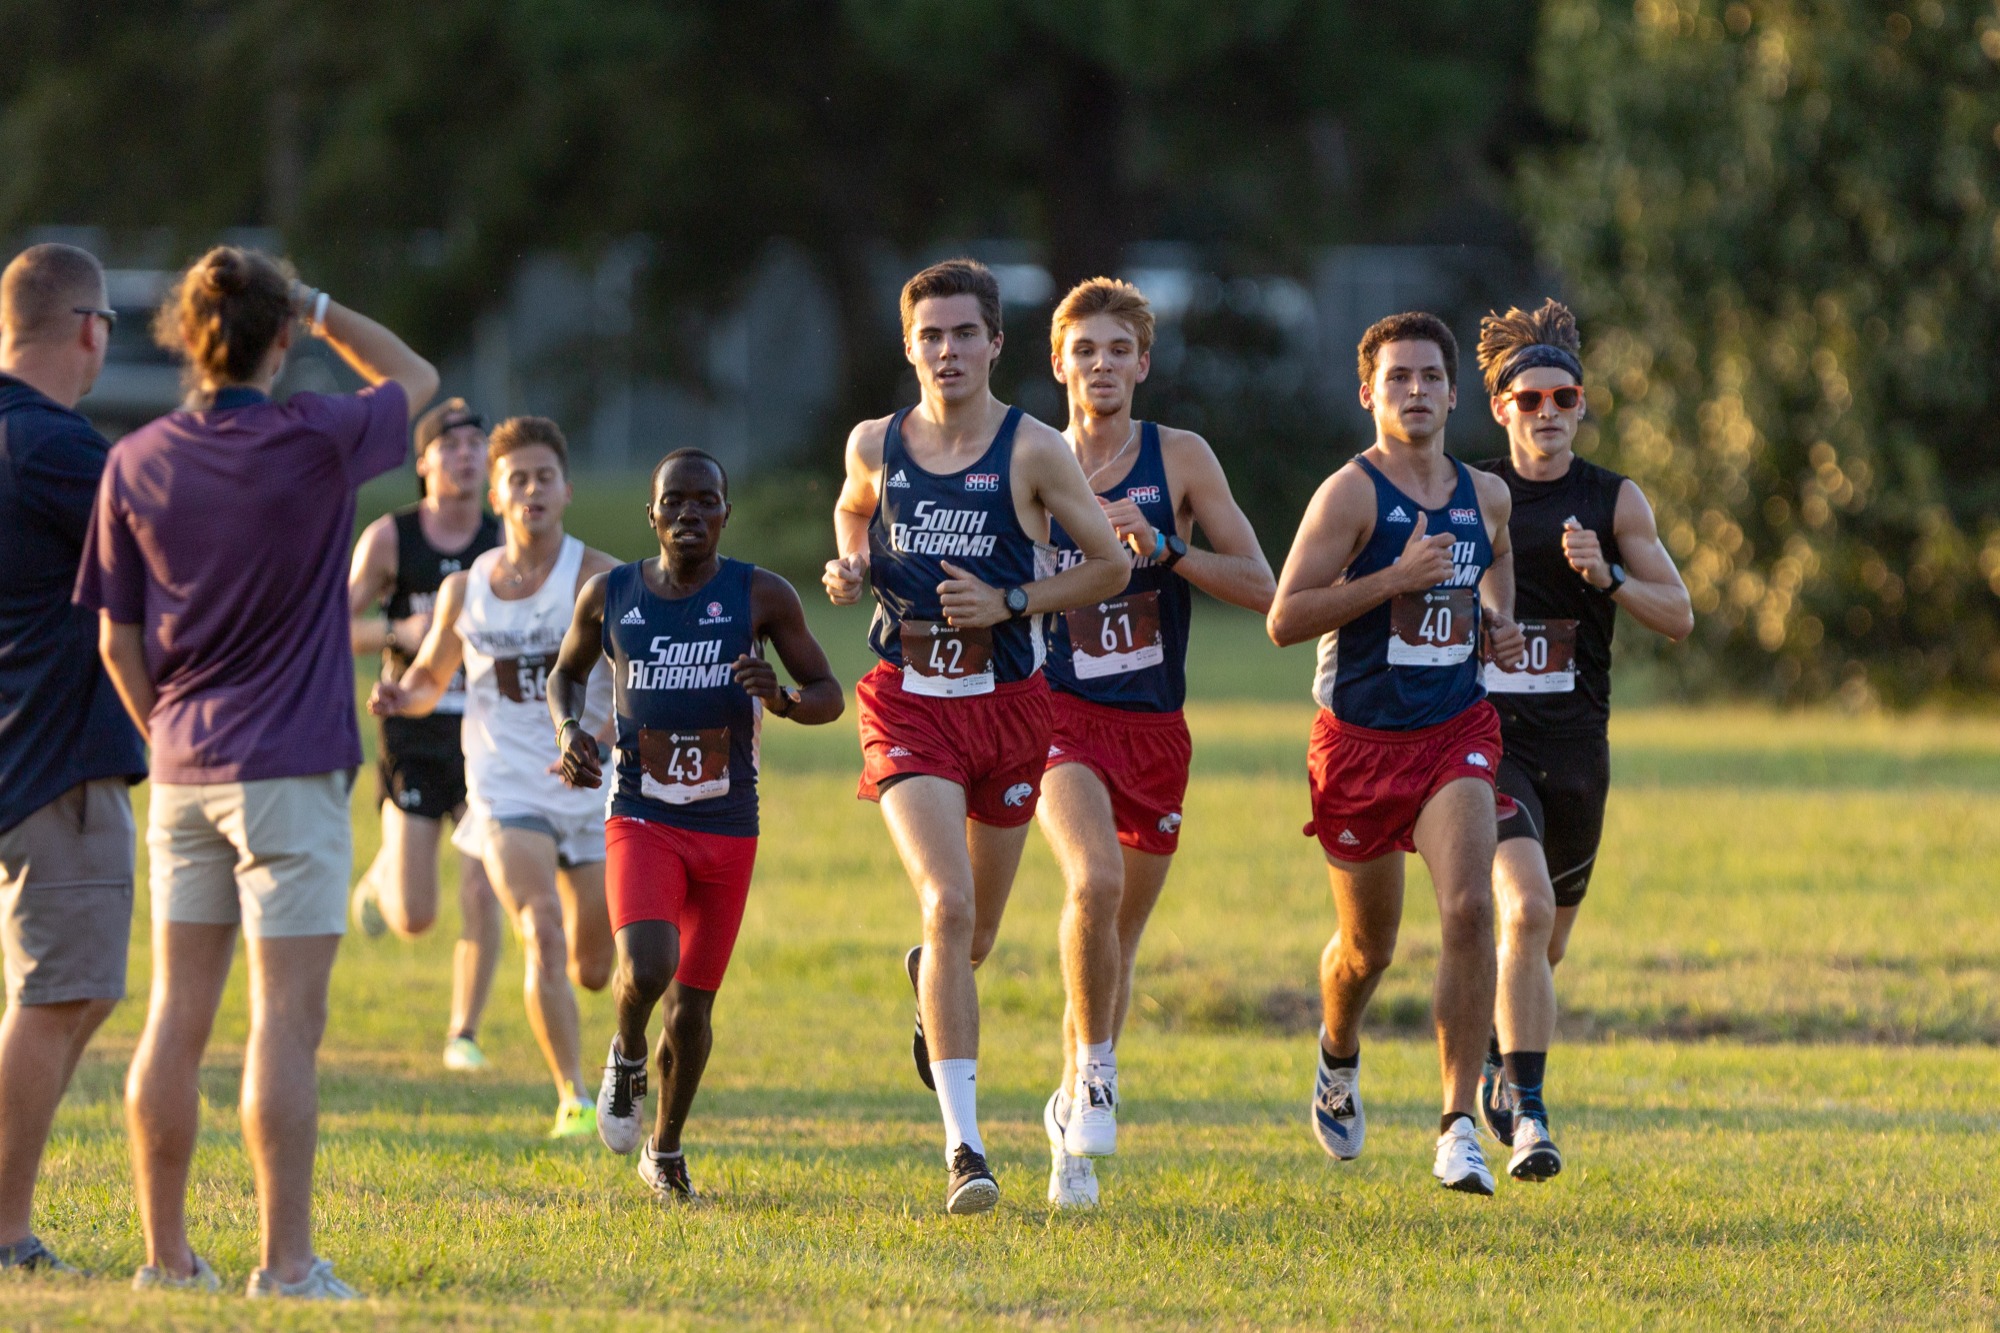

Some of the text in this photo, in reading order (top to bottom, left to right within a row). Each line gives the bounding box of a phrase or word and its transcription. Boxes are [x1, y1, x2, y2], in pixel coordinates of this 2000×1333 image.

[887, 480, 910, 489] adidas
[965, 474, 999, 491] SBC
[1127, 486, 1160, 504] SBC
[1386, 515, 1411, 523] adidas
[1450, 508, 1478, 525] SBC
[620, 616, 645, 625] adidas
[1419, 607, 1452, 642] 40
[1101, 613, 1133, 651] 61
[929, 638, 964, 673] 42
[667, 746, 703, 781] 43
